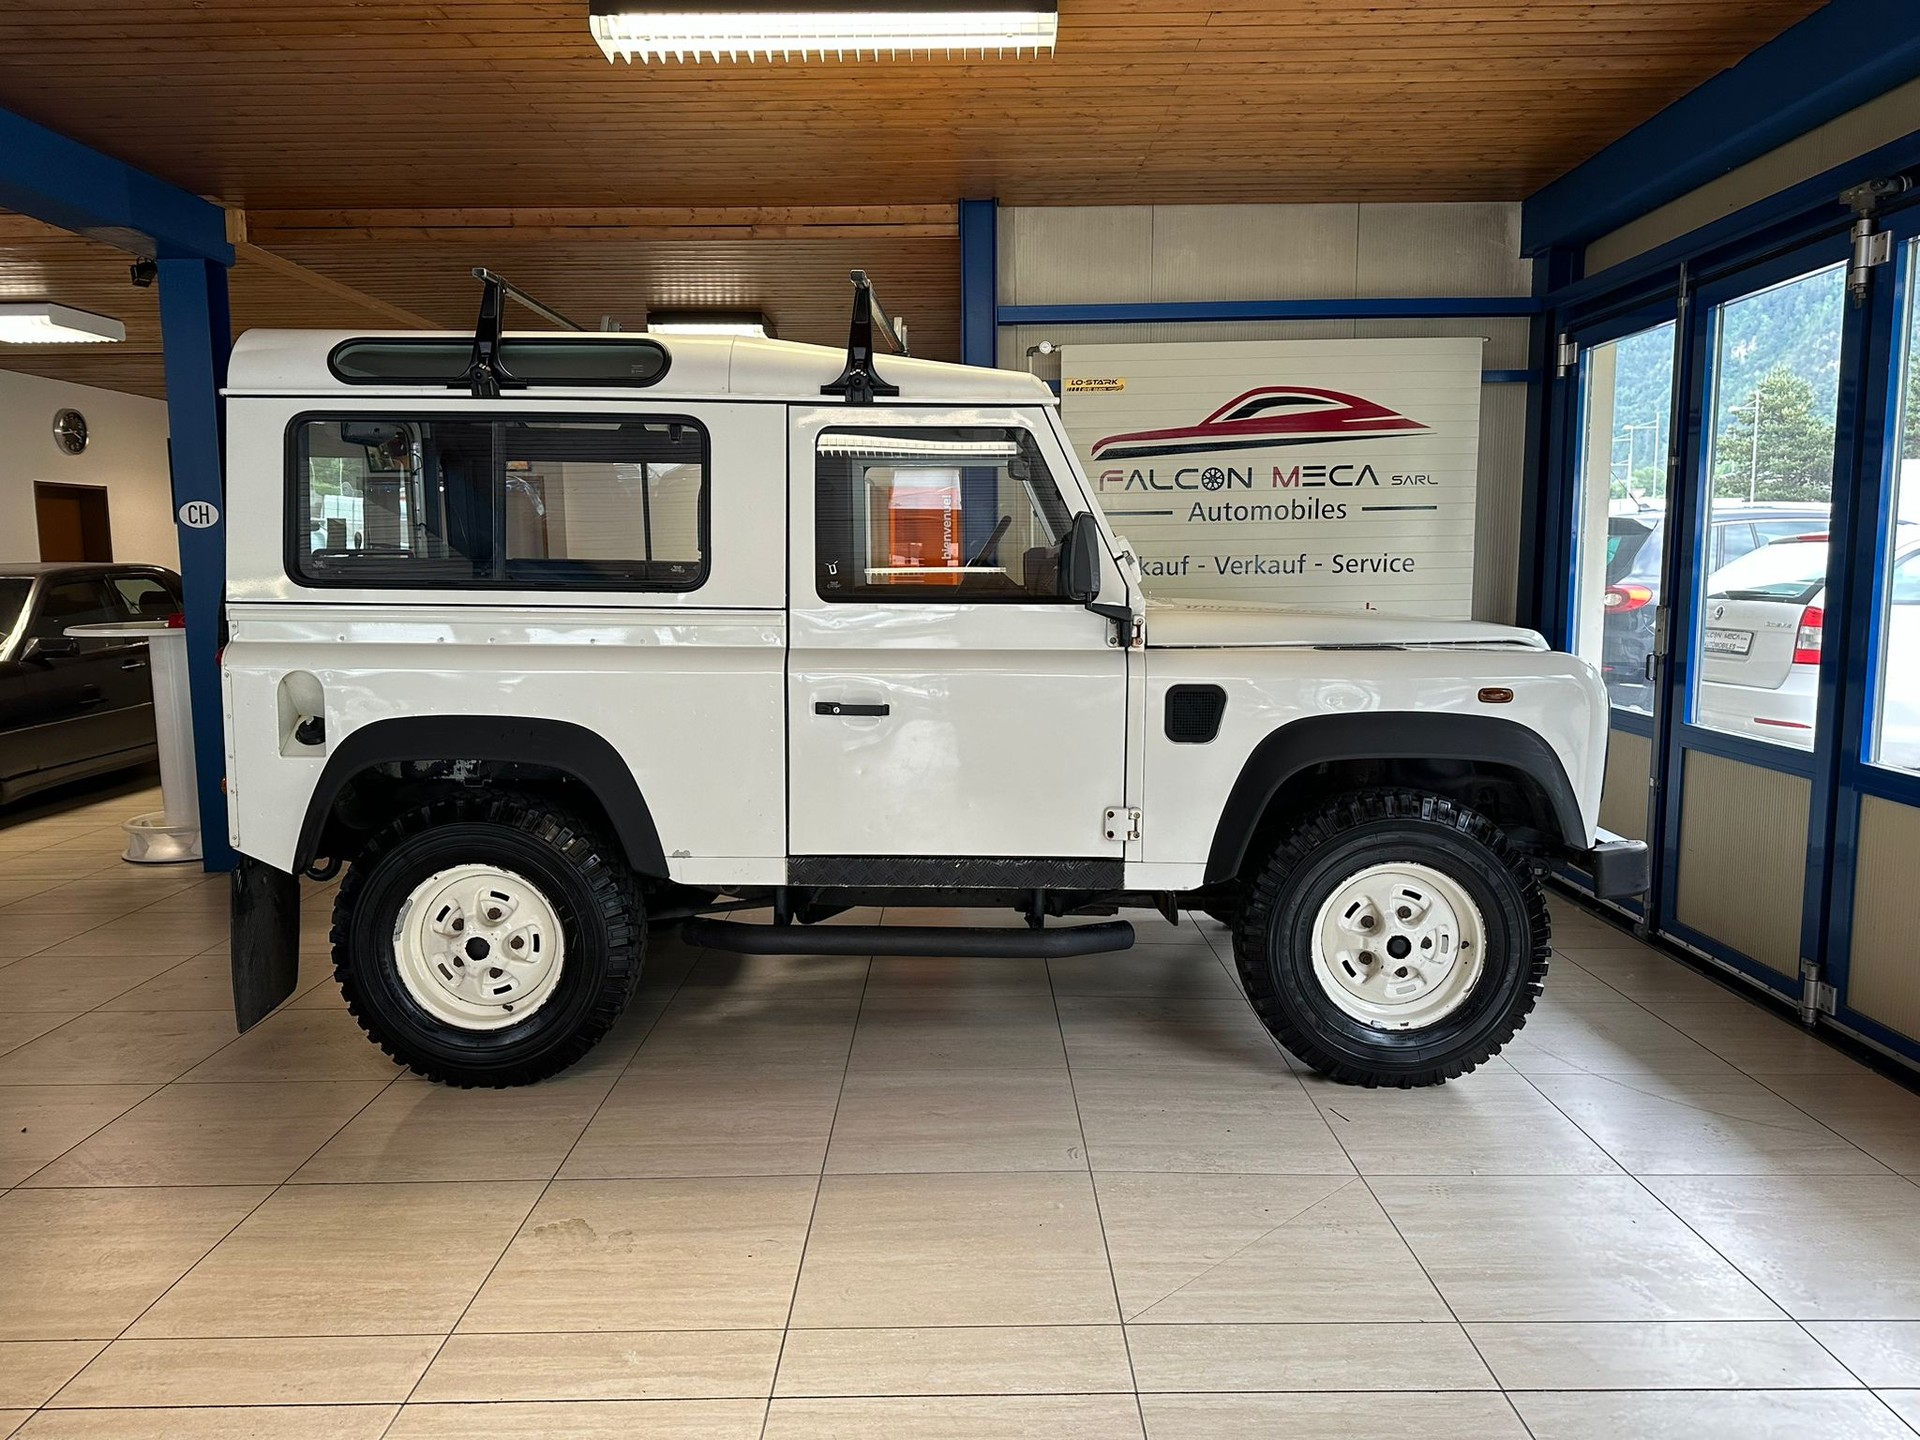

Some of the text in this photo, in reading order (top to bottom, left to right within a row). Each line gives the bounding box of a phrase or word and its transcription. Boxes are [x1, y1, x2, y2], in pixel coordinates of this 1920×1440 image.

[1099, 464, 1438, 492] FALCON MECA SARL
[188, 504, 210, 525] CH
[1188, 497, 1347, 522] Automobiles
[1139, 555, 1190, 576] kauf
[1214, 553, 1307, 575] Verkauf
[1331, 553, 1415, 574] Service
